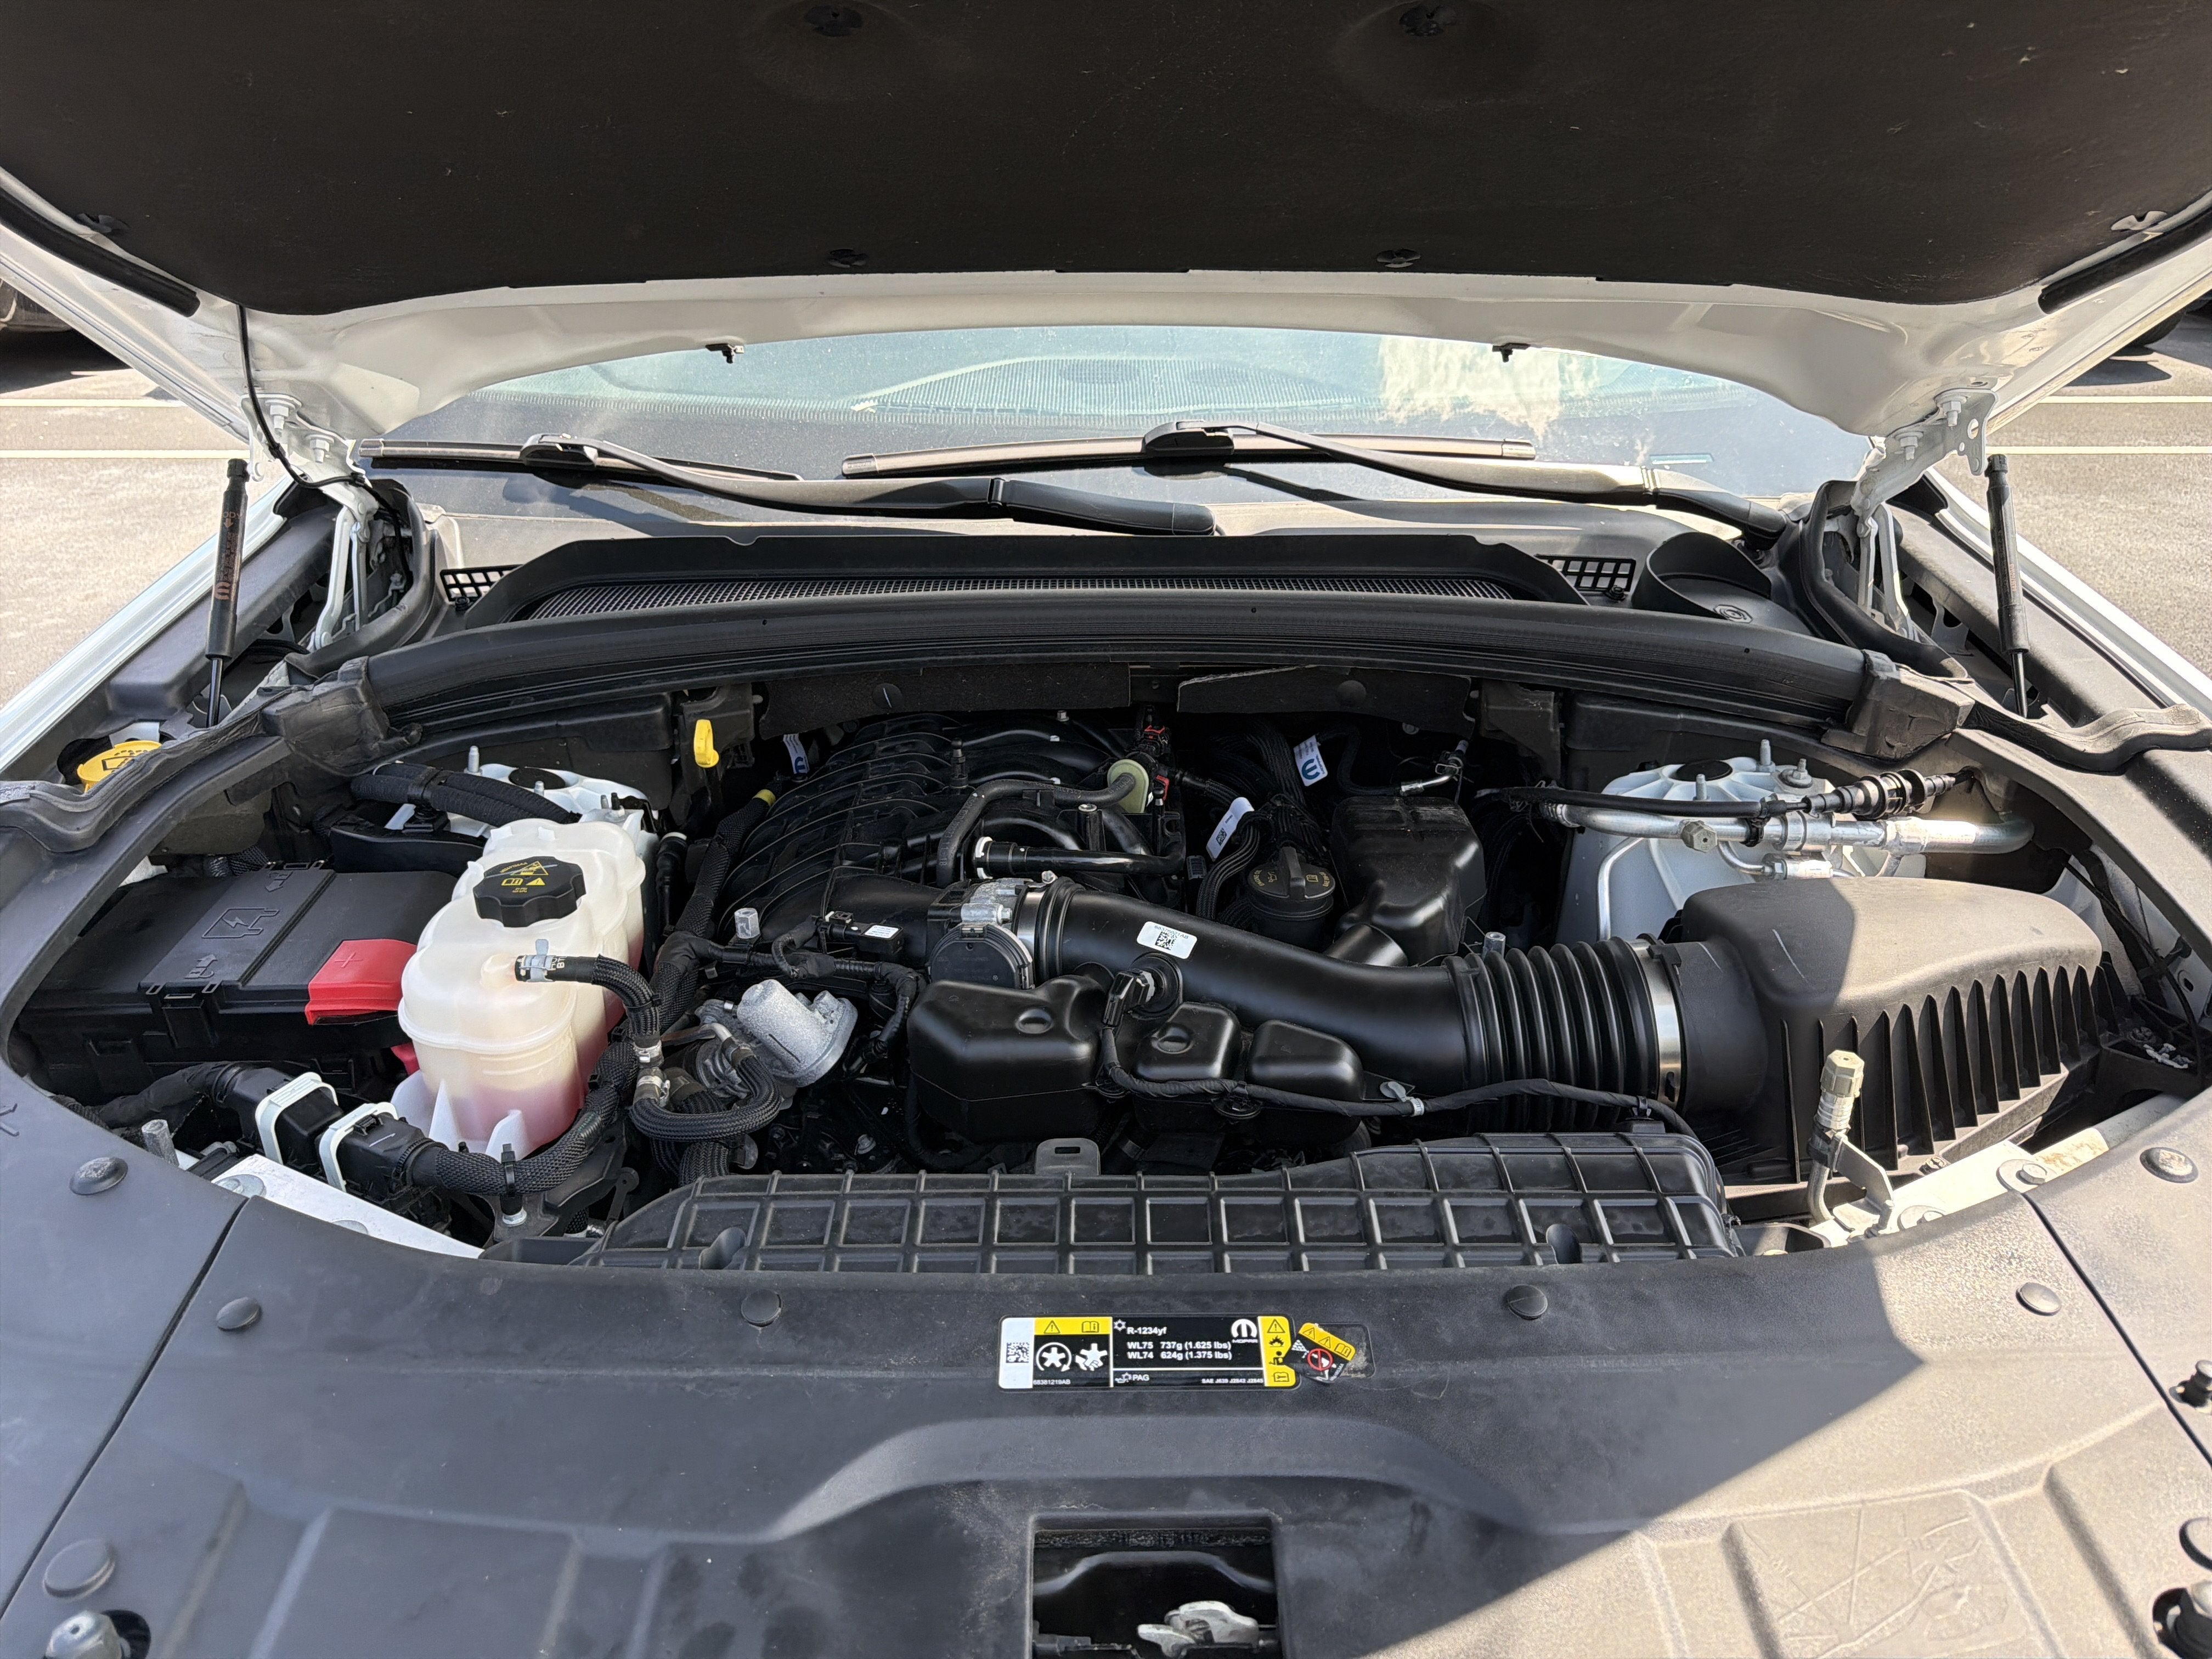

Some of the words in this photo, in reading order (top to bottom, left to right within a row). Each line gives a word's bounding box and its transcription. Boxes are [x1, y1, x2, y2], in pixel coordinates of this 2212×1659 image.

[1126, 1327, 1167, 1336] R-1234yf
[1160, 1341, 1183, 1351] 737g
[1184, 1341, 1212, 1351] (1.625
[1214, 1341, 1232, 1351] lbs)
[1160, 1351, 1183, 1361] 624g
[1185, 1351, 1213, 1360] (1.375
[1215, 1351, 1232, 1360] lbs)
